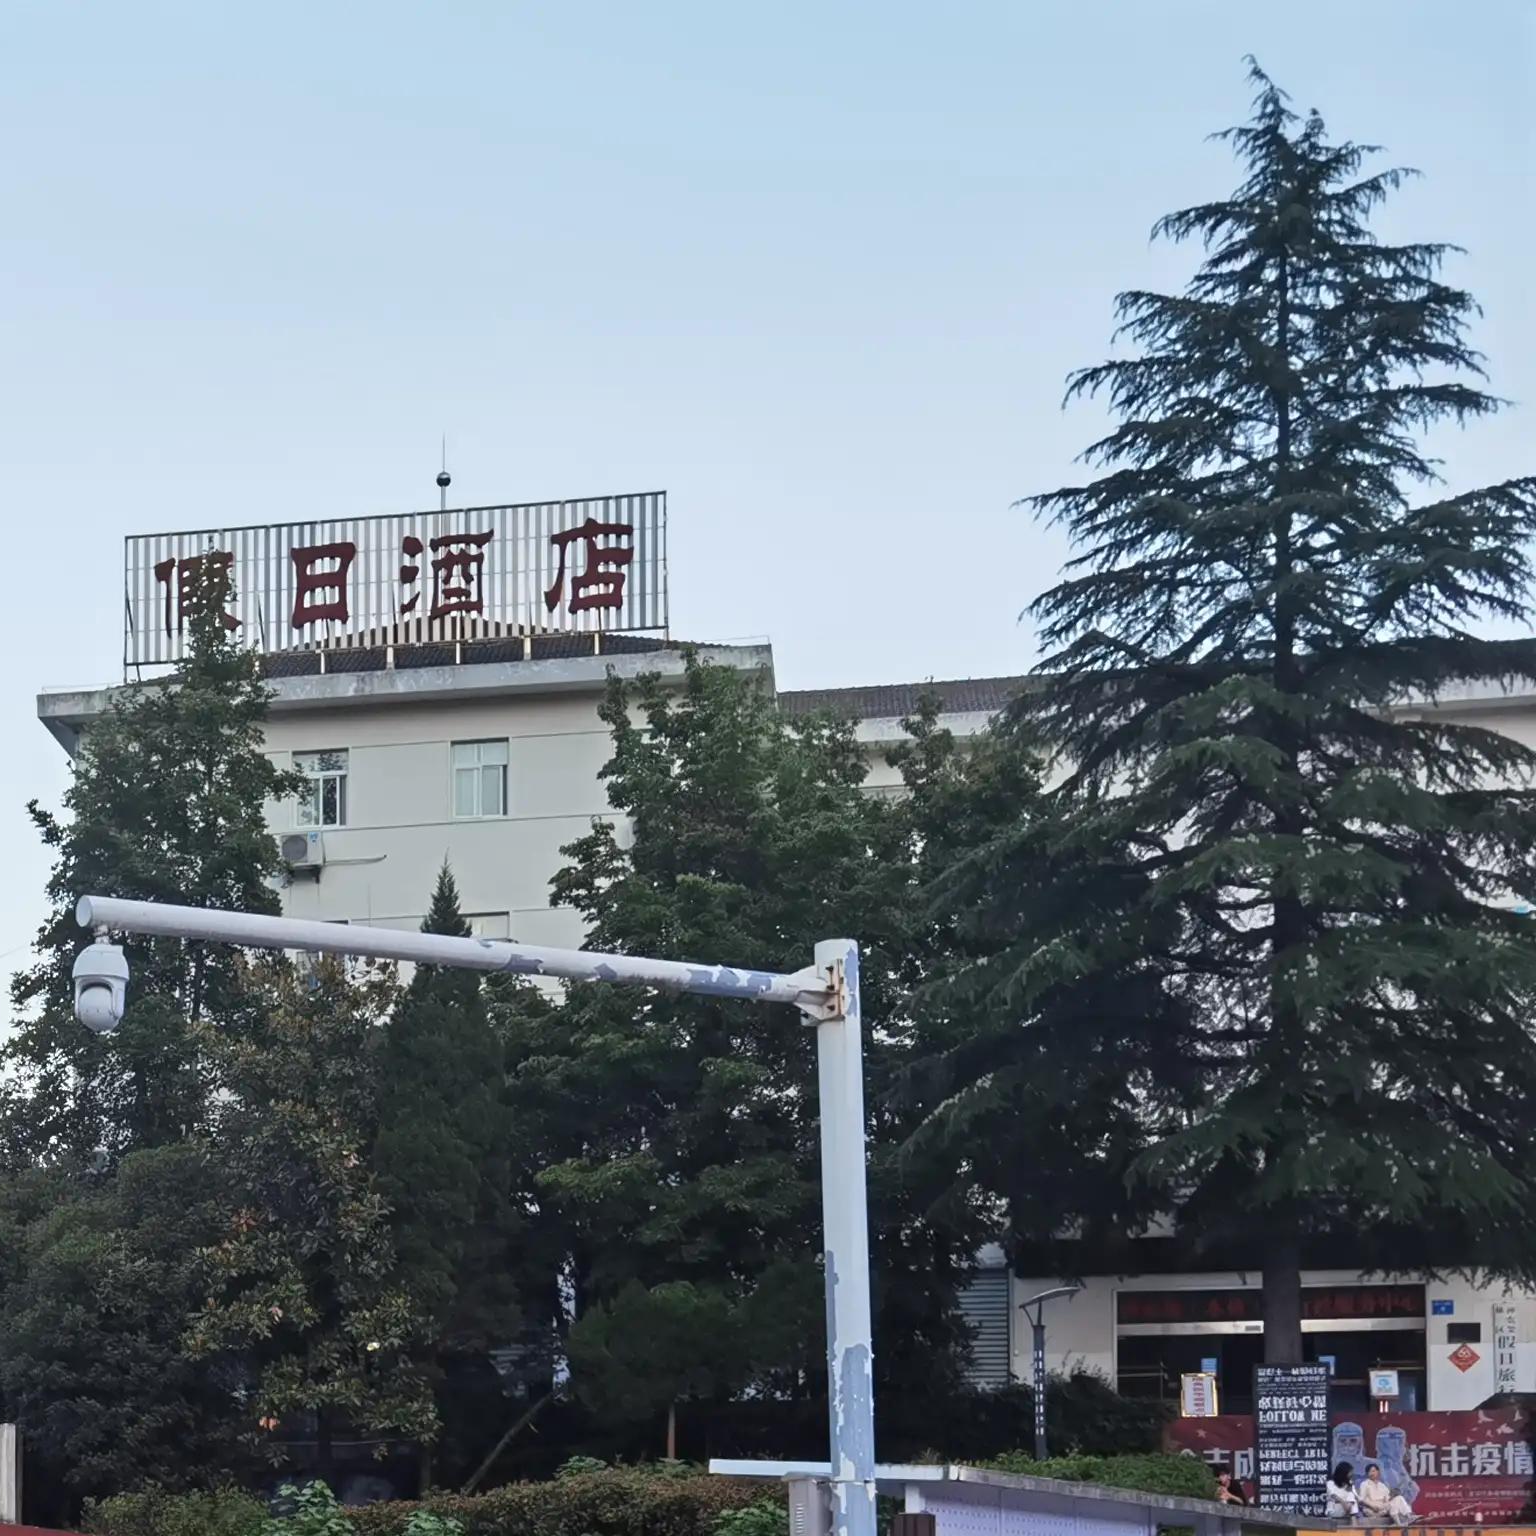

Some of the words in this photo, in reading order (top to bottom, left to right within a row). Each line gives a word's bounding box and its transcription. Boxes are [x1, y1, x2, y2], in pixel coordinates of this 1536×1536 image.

[153, 517, 635, 639] 假日酒店
[1408, 1440, 1534, 1477] 抗击疫情
